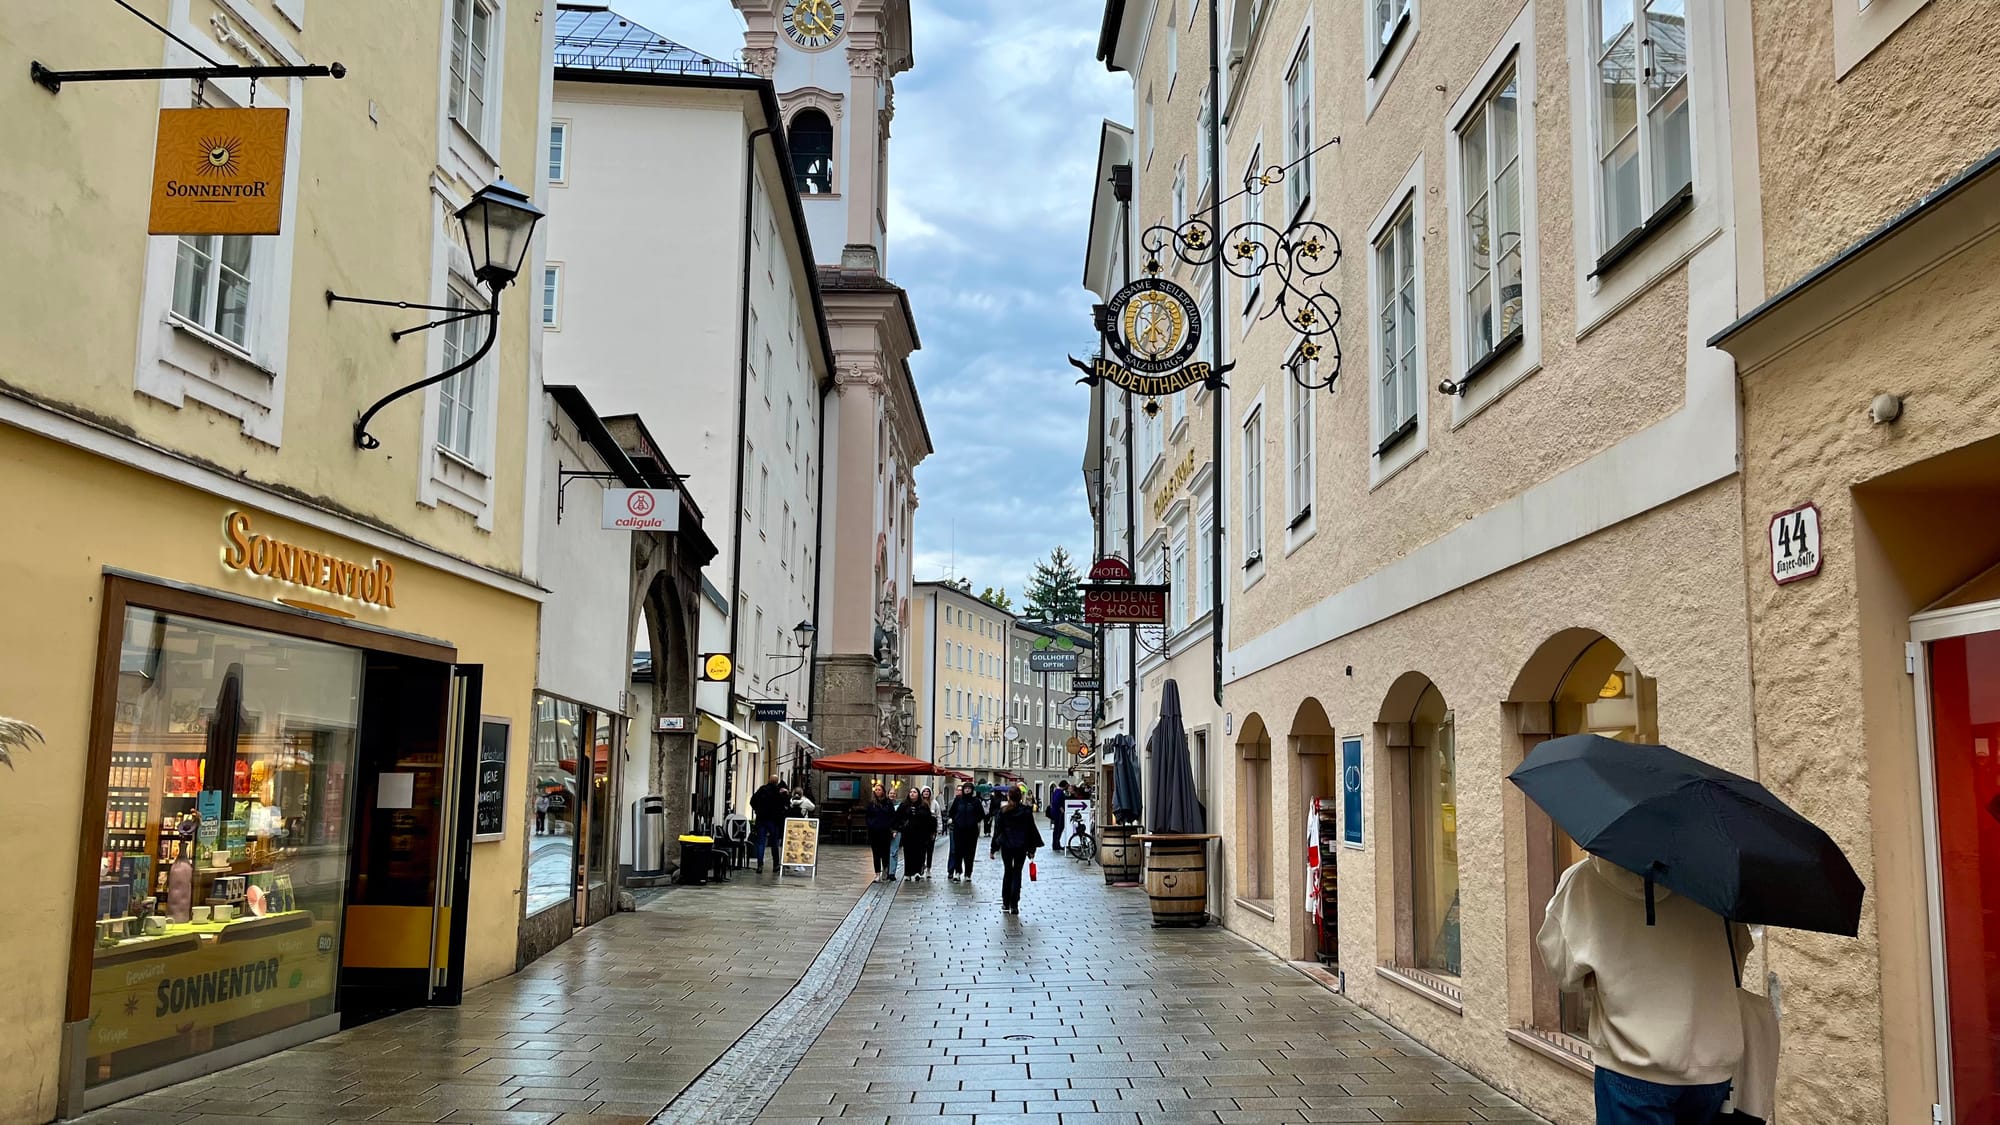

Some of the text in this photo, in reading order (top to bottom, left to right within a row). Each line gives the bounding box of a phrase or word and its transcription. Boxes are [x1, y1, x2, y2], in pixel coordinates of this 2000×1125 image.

[166, 180, 266, 197] SONNENTOR
[1107, 281, 1200, 336] DIE EHRSAME SEILERZUNFT
[1125, 354, 1184, 371] SALZBURGS
[1096, 361, 1209, 393] HAIDENTHALLER
[615, 517, 662, 529] caligula
[1778, 512, 1808, 558] 44
[225, 511, 396, 608] SONNENTOR
[1092, 568, 1127, 577] HOTEL
[1088, 590, 1156, 603] GOLDENE
[1107, 604, 1159, 617] KRONE
[319, 936, 332, 949] BIO
[157, 958, 279, 1016] SONNENTOR
